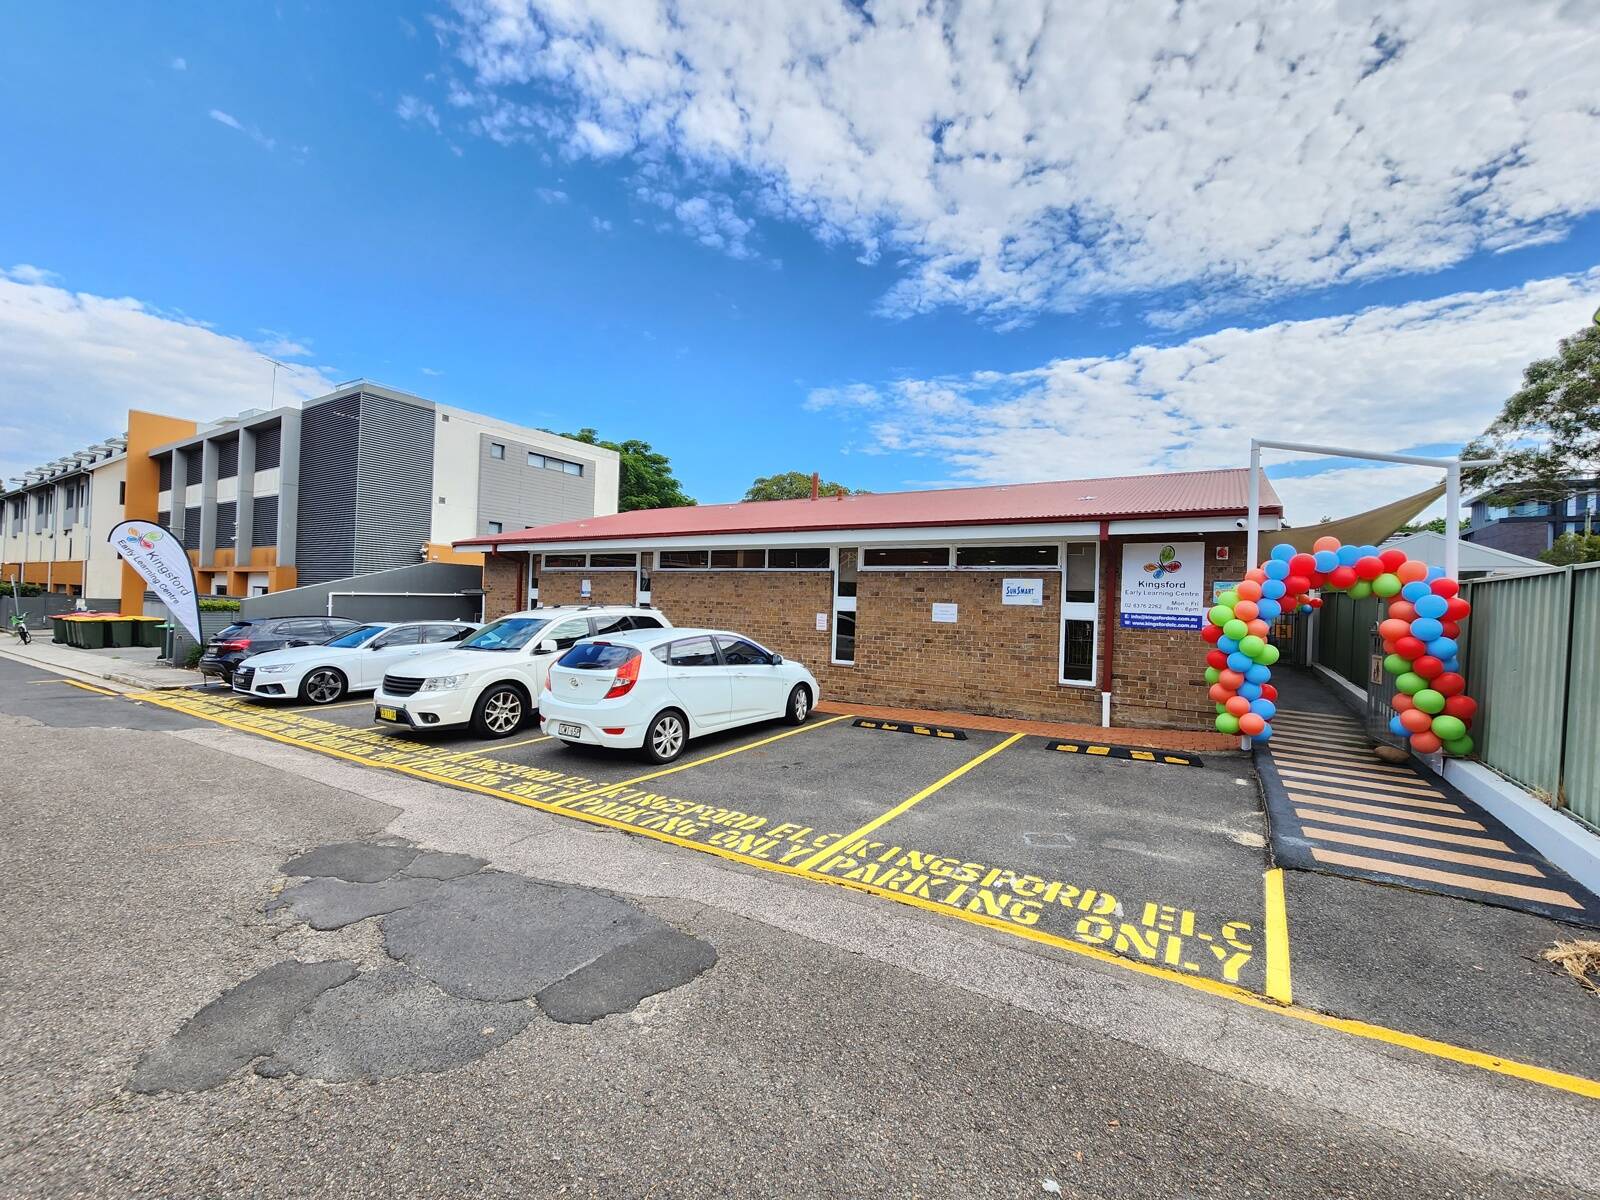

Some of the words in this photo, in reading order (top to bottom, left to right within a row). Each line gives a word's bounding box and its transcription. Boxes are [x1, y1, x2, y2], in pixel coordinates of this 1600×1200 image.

[118, 540, 135, 557] Early
[134, 556, 160, 584] Learning
[159, 583, 180, 605] Centre
[146, 551, 191, 596] Kingsford
[1138, 580, 1186, 589] Kingsford
[566, 797, 710, 836] PARKING
[708, 830, 815, 863] ONLY
[599, 787, 768, 830] KINGSFORD
[765, 823, 843, 848] ELC
[817, 855, 1043, 925] PARKING
[1076, 915, 1251, 982] ONLY
[844, 839, 1117, 915] KINGSFORD
[1141, 902, 1252, 951] ELC
